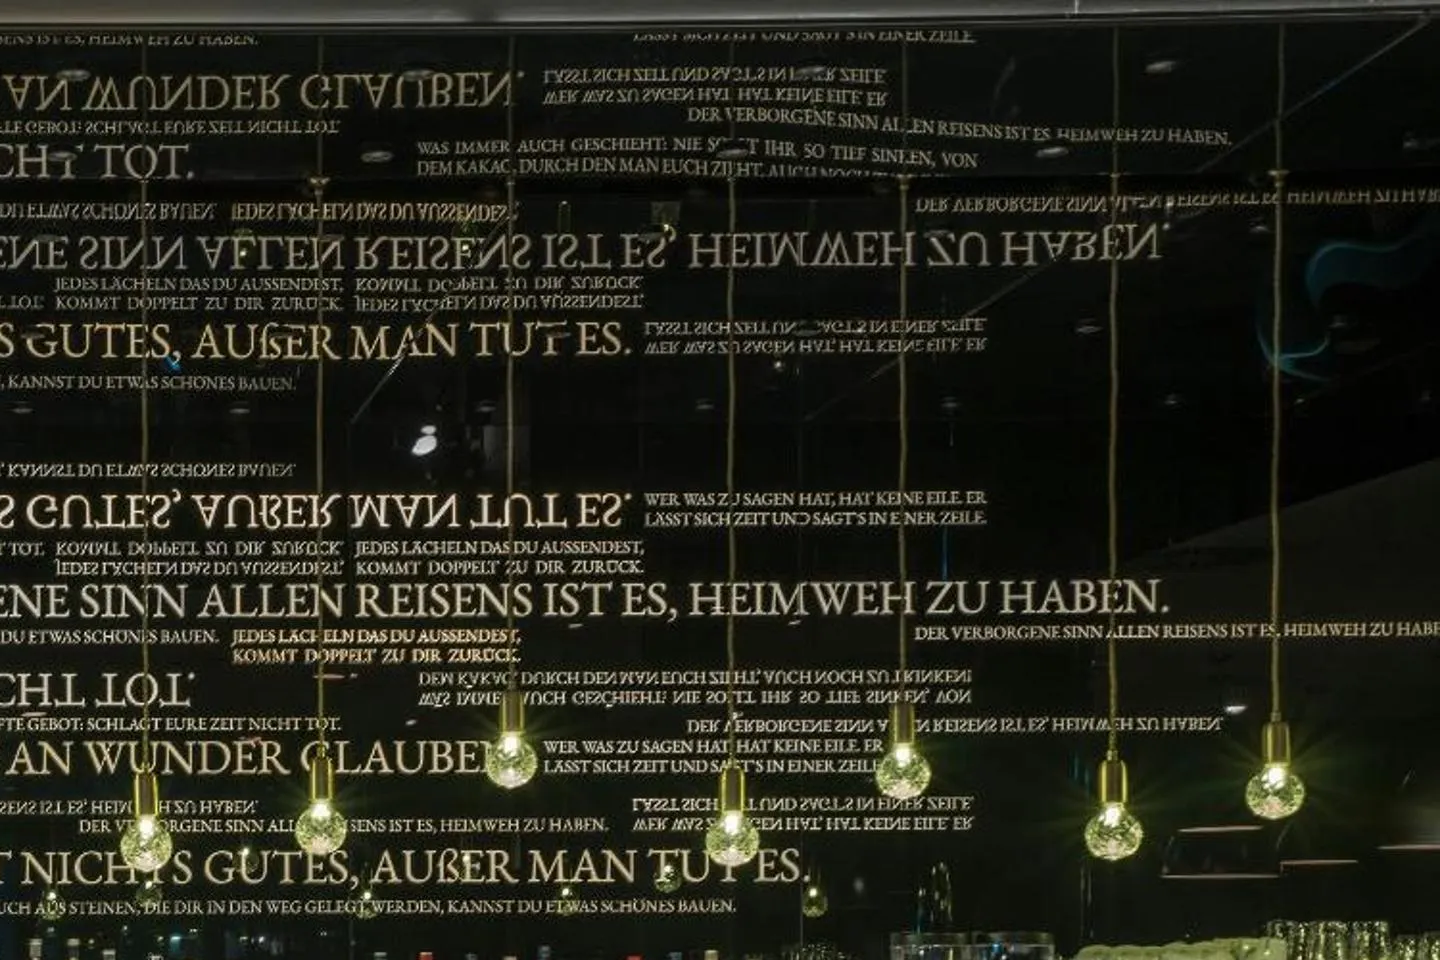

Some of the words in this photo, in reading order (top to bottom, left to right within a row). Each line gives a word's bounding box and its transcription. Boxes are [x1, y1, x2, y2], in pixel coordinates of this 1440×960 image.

[94, 143, 194, 179] TOT.
[26, 322, 182, 364] GUTES,
[349, 321, 459, 359] MAN
[575, 321, 631, 355] ES.
[10, 542, 45, 556] TOT.
[354, 541, 400, 557] JEDES
[401, 540, 478, 556] LÄCHELN
[481, 541, 511, 556] DAS
[513, 541, 539, 556] DU
[541, 541, 645, 557] AUSSENDEST,
[356, 560, 421, 576] KOMMT
[428, 560, 501, 576] DOPPELT
[534, 560, 566, 575] DIR
[79, 583, 189, 620] SINN
[197, 582, 346, 619] ALLEN
[355, 582, 533, 618] REISENS
[543, 581, 613, 618] IST
[622, 582, 678, 623] ES,
[689, 581, 916, 618] HEIMWEH
[926, 580, 990, 615] ZU
[1000, 579, 1170, 614] HABEN.
[914, 626, 949, 641] DER
[950, 625, 1061, 640] VERBORGENE
[1063, 625, 1104, 639] SINN
[1162, 624, 1228, 639] REISENS
[1231, 624, 1259, 638] IST
[1283, 622, 1366, 637] HEIMWEH
[1368, 622, 1394, 637] ZU
[10, 741, 74, 776] AN
[85, 740, 292, 777] WUNDER
[204, 849, 360, 890] GUTES,
[528, 849, 638, 883] MAN
[758, 847, 811, 882] ES.
